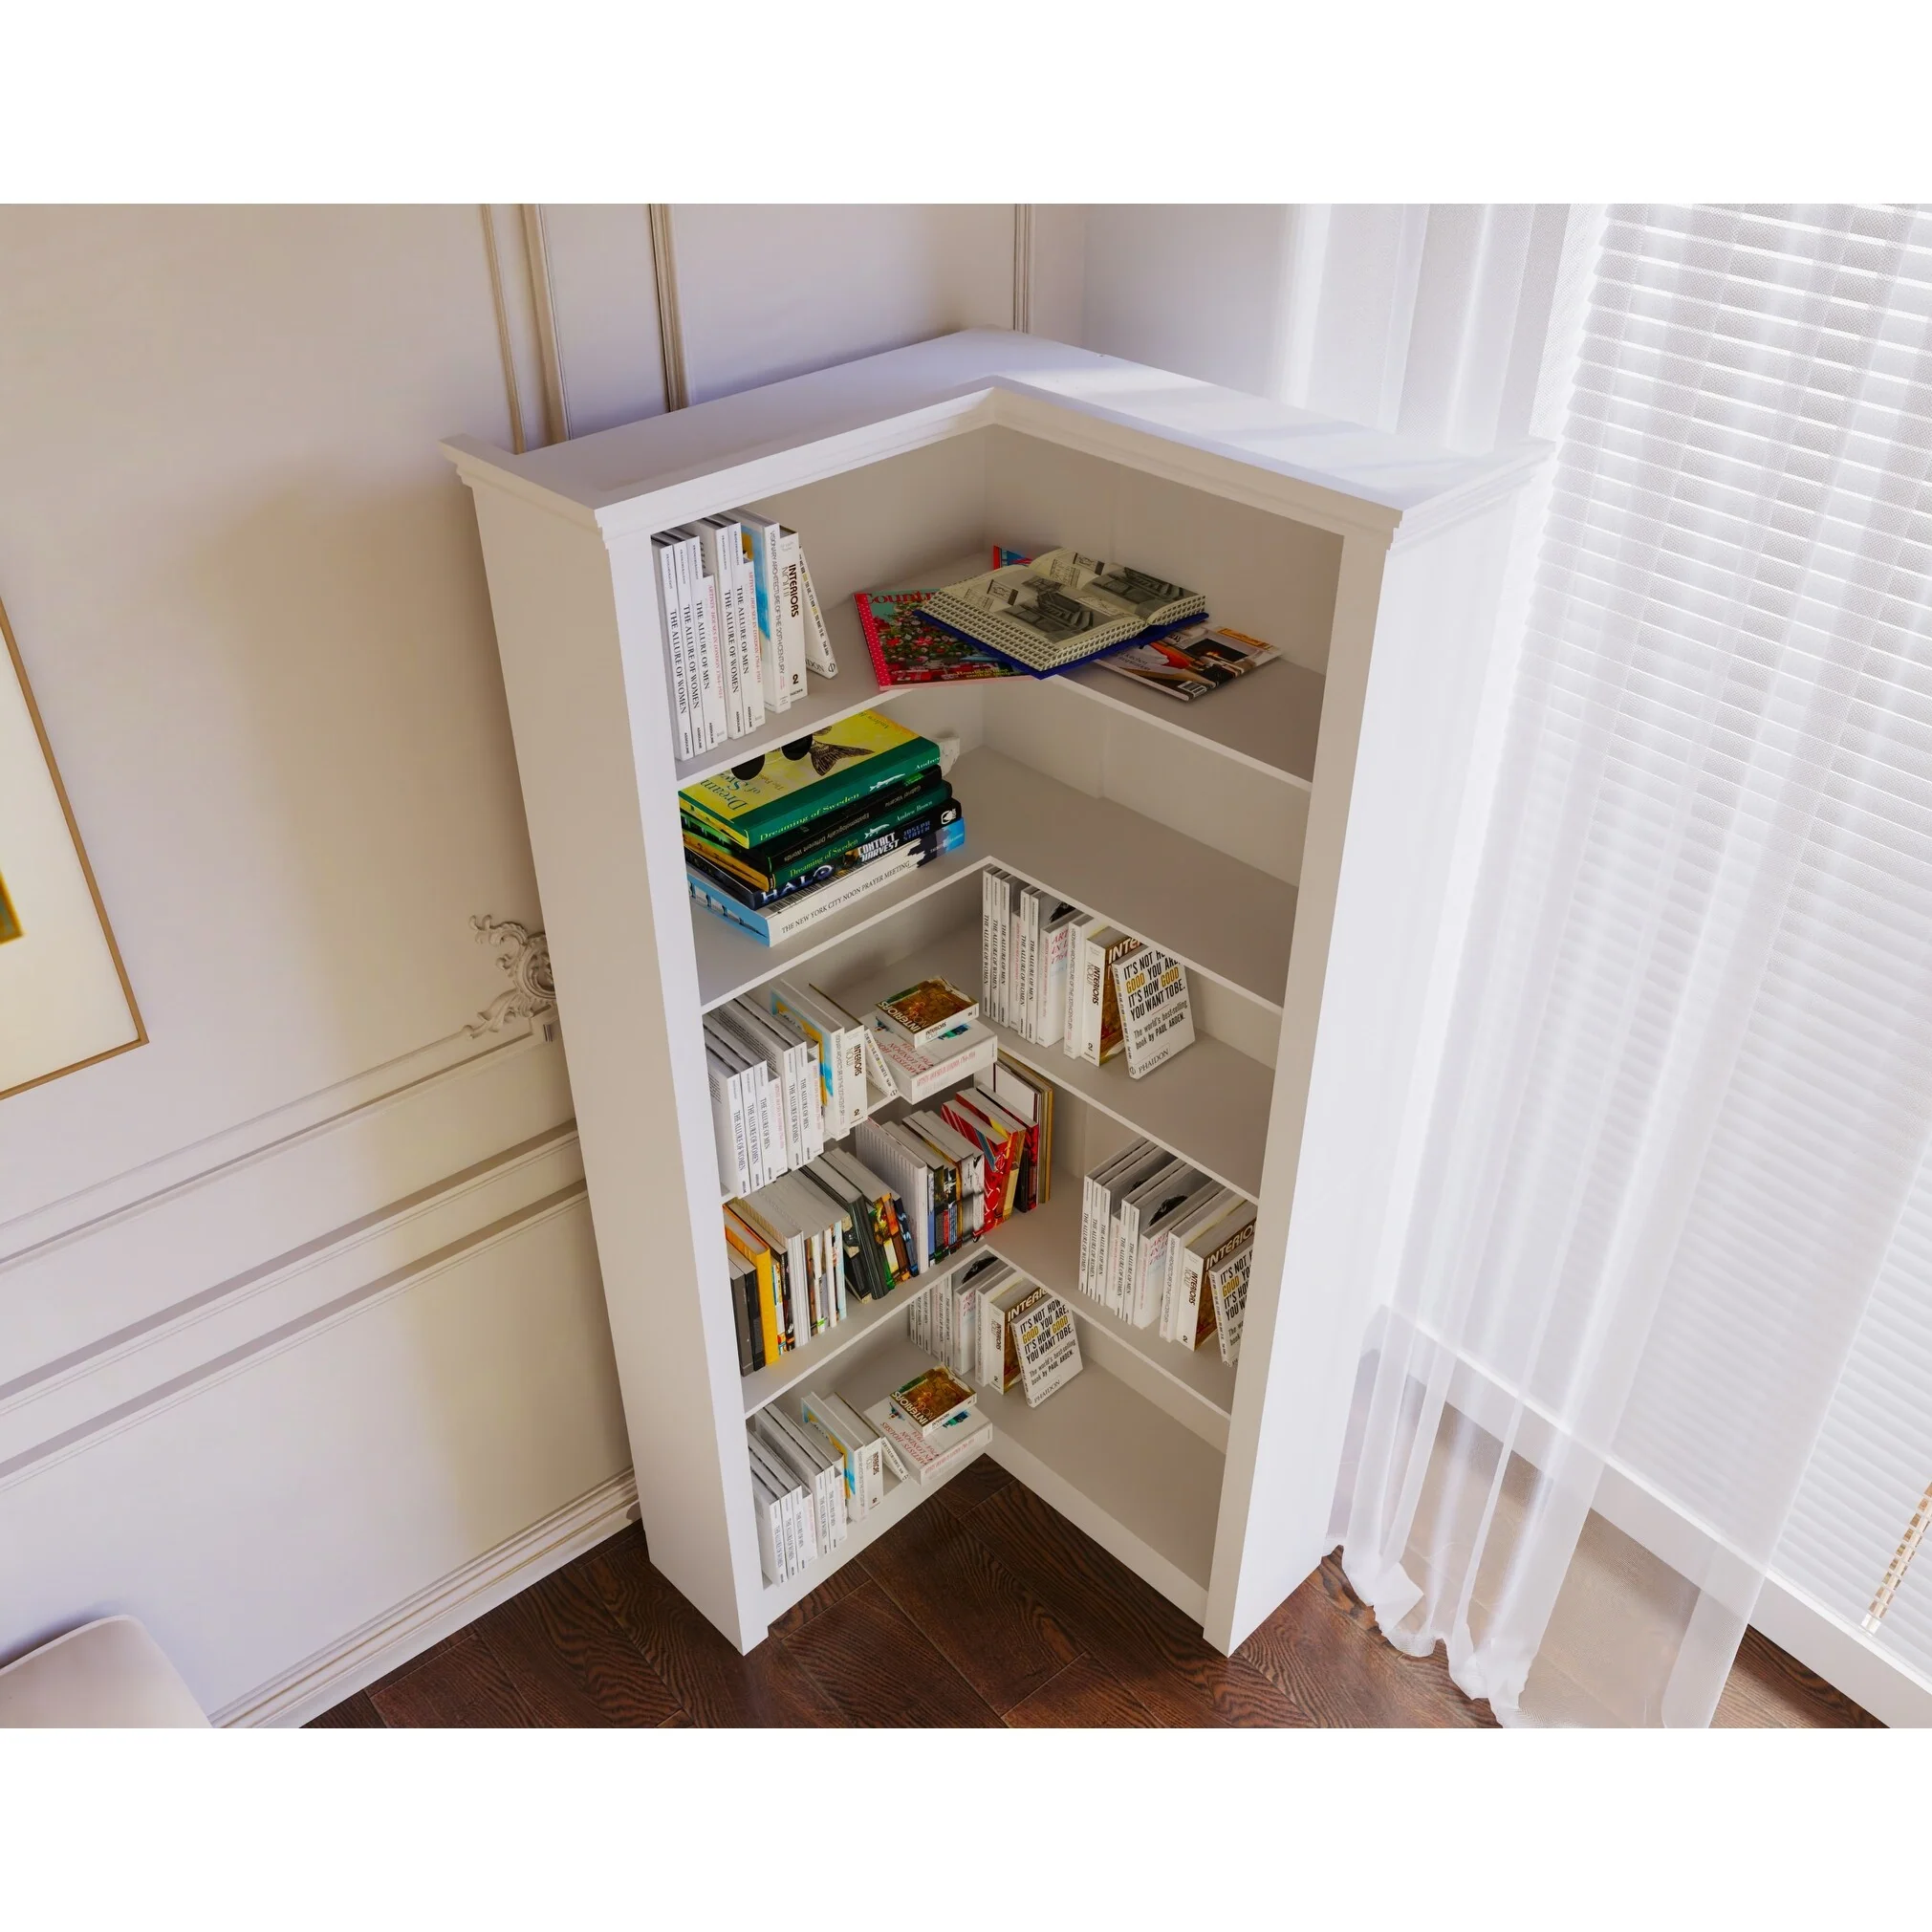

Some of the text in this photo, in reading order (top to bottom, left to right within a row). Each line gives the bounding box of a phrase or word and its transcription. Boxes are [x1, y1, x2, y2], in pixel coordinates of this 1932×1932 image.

[789, 564, 799, 618] INTERIORS
[774, 605, 780, 615] OF
[685, 626, 695, 662] ALLURE
[698, 621, 706, 655] ALLURE
[726, 612, 735, 646] ALLURE
[728, 647, 736, 660] OF
[740, 640, 747, 652] OF
[670, 611, 687, 714] THE ALLURE OF WOMEN
[688, 662, 696, 675] OF
[701, 657, 707, 669] OF
[729, 661, 739, 692] WOMEN
[690, 675, 700, 708] WOMEN
[792, 674, 798, 684] 2
[701, 779, 747, 811] Dream
[760, 792, 859, 841] Dreaming of Sweden
[903, 821, 931, 836] JOSEPH
[790, 838, 858, 878] Dreaming of Sweden
[857, 833, 896, 855] CONTACT
[861, 838, 900, 861] HARVEST
[761, 864, 833, 902] HALO
[782, 860, 910, 934] THE NEW YORK CITY NOON PRAYER MEETING
[984, 950, 988, 959] OF
[1124, 962, 1138, 980] IT'S
[1140, 952, 1153, 970] NOT
[1093, 966, 1101, 1006] INTERIORS
[1126, 973, 1145, 993] GOOD
[1148, 962, 1161, 980] YOU
[1128, 966, 1180, 1008] IT'S HOW GOOD
[879, 1001, 921, 1032] INTERIORS
[1130, 1003, 1144, 1021] YOU
[1145, 990, 1164, 1012] WANT
[1134, 1000, 1188, 1038] The world's best-selling
[1136, 1012, 1185, 1050] book by PAUL ARDEN.
[1139, 1049, 1169, 1074] PHAIDON
[1206, 1224, 1256, 1270] INTERIO
[1220, 1266, 1233, 1285] IT'S
[1234, 1254, 1248, 1273] NOT
[1223, 1265, 1250, 1297] GOOD YO
[1188, 1271, 1198, 1306] INTERIORS
[1224, 1291, 1237, 1310] IT'S
[1020, 1299, 1061, 1335] IT'S NOT HOW
[1022, 1305, 1070, 1344] GOOD YOU ARE,
[1226, 1304, 1239, 1321] YOU
[1024, 1315, 1069, 1355] IT'S HOW GOOD
[1228, 1325, 1237, 1337] The
[1026, 1351, 1039, 1365] YOU
[1039, 1337, 1055, 1356] WANT
[1048, 1362, 1058, 1373] PAUL
[1034, 1380, 1060, 1403] PHAIDON
[892, 1392, 928, 1424] INTERIORS
